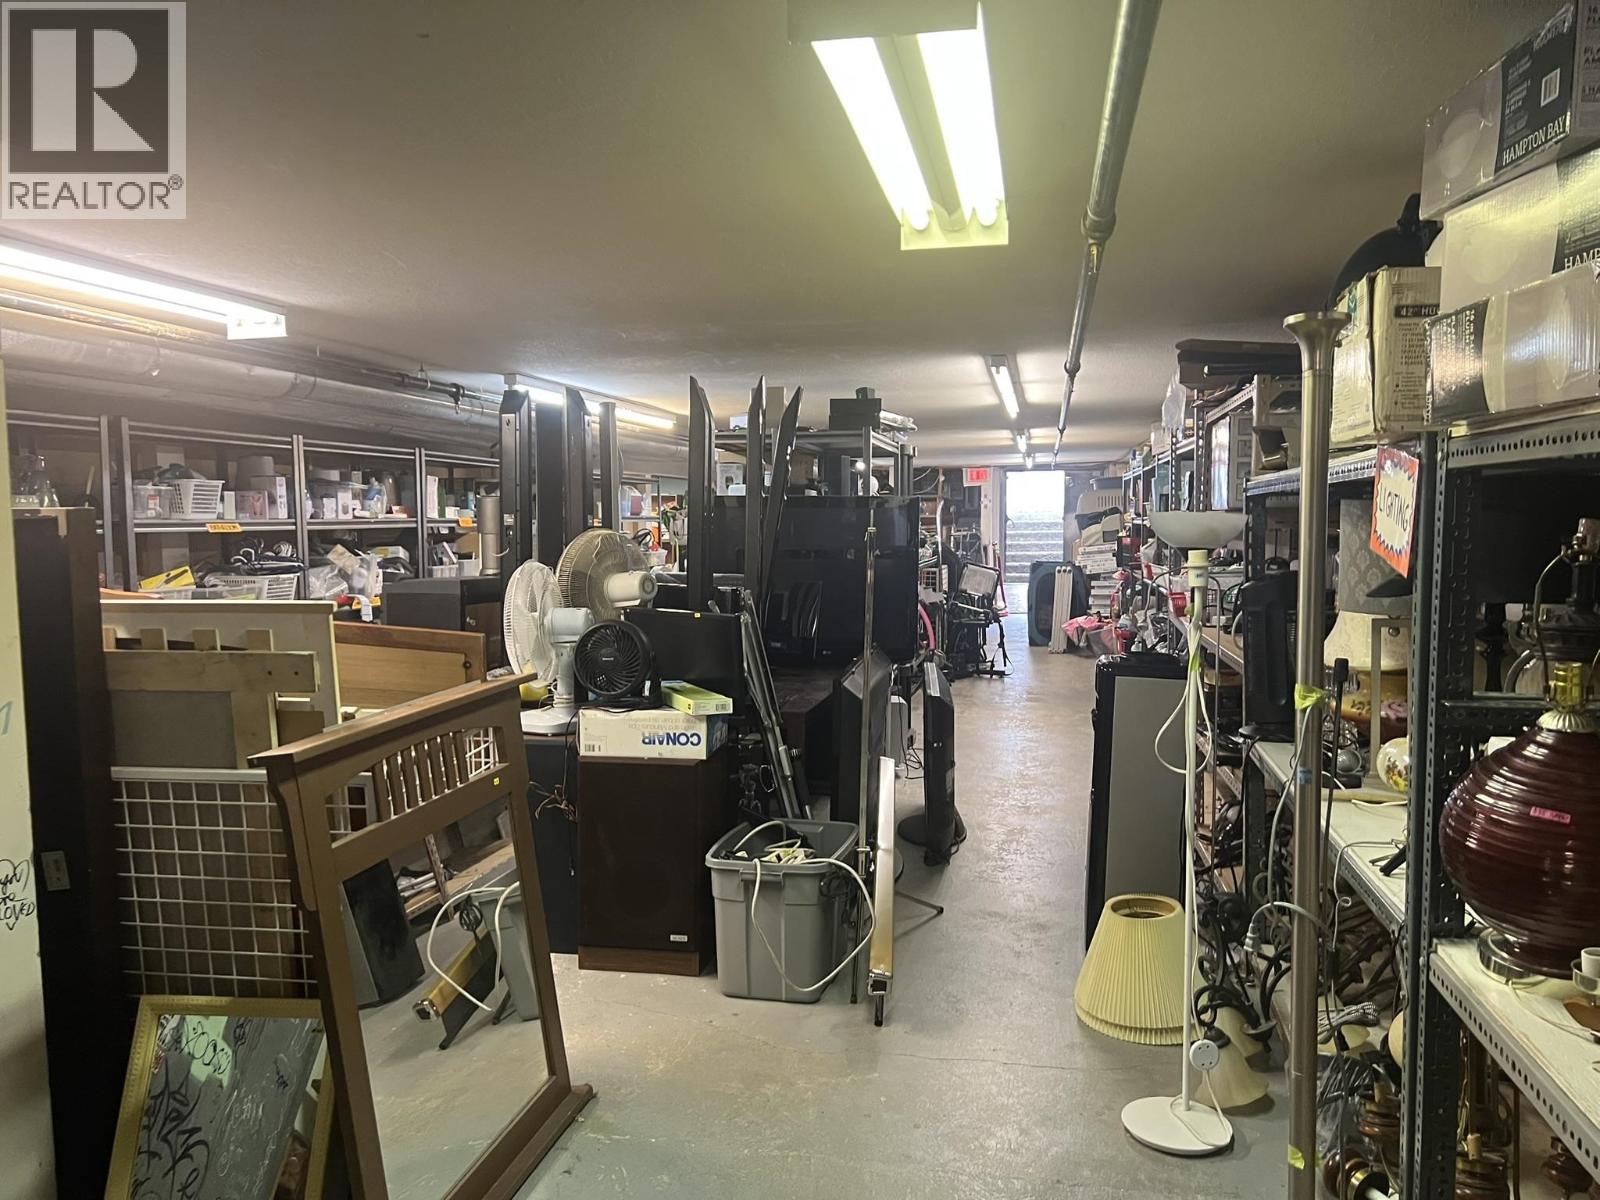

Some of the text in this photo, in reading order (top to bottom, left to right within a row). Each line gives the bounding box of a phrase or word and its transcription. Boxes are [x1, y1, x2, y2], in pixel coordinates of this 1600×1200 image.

[1502, 115, 1567, 166] HAMPTON BAY
[641, 732, 702, 746] CONAIR
